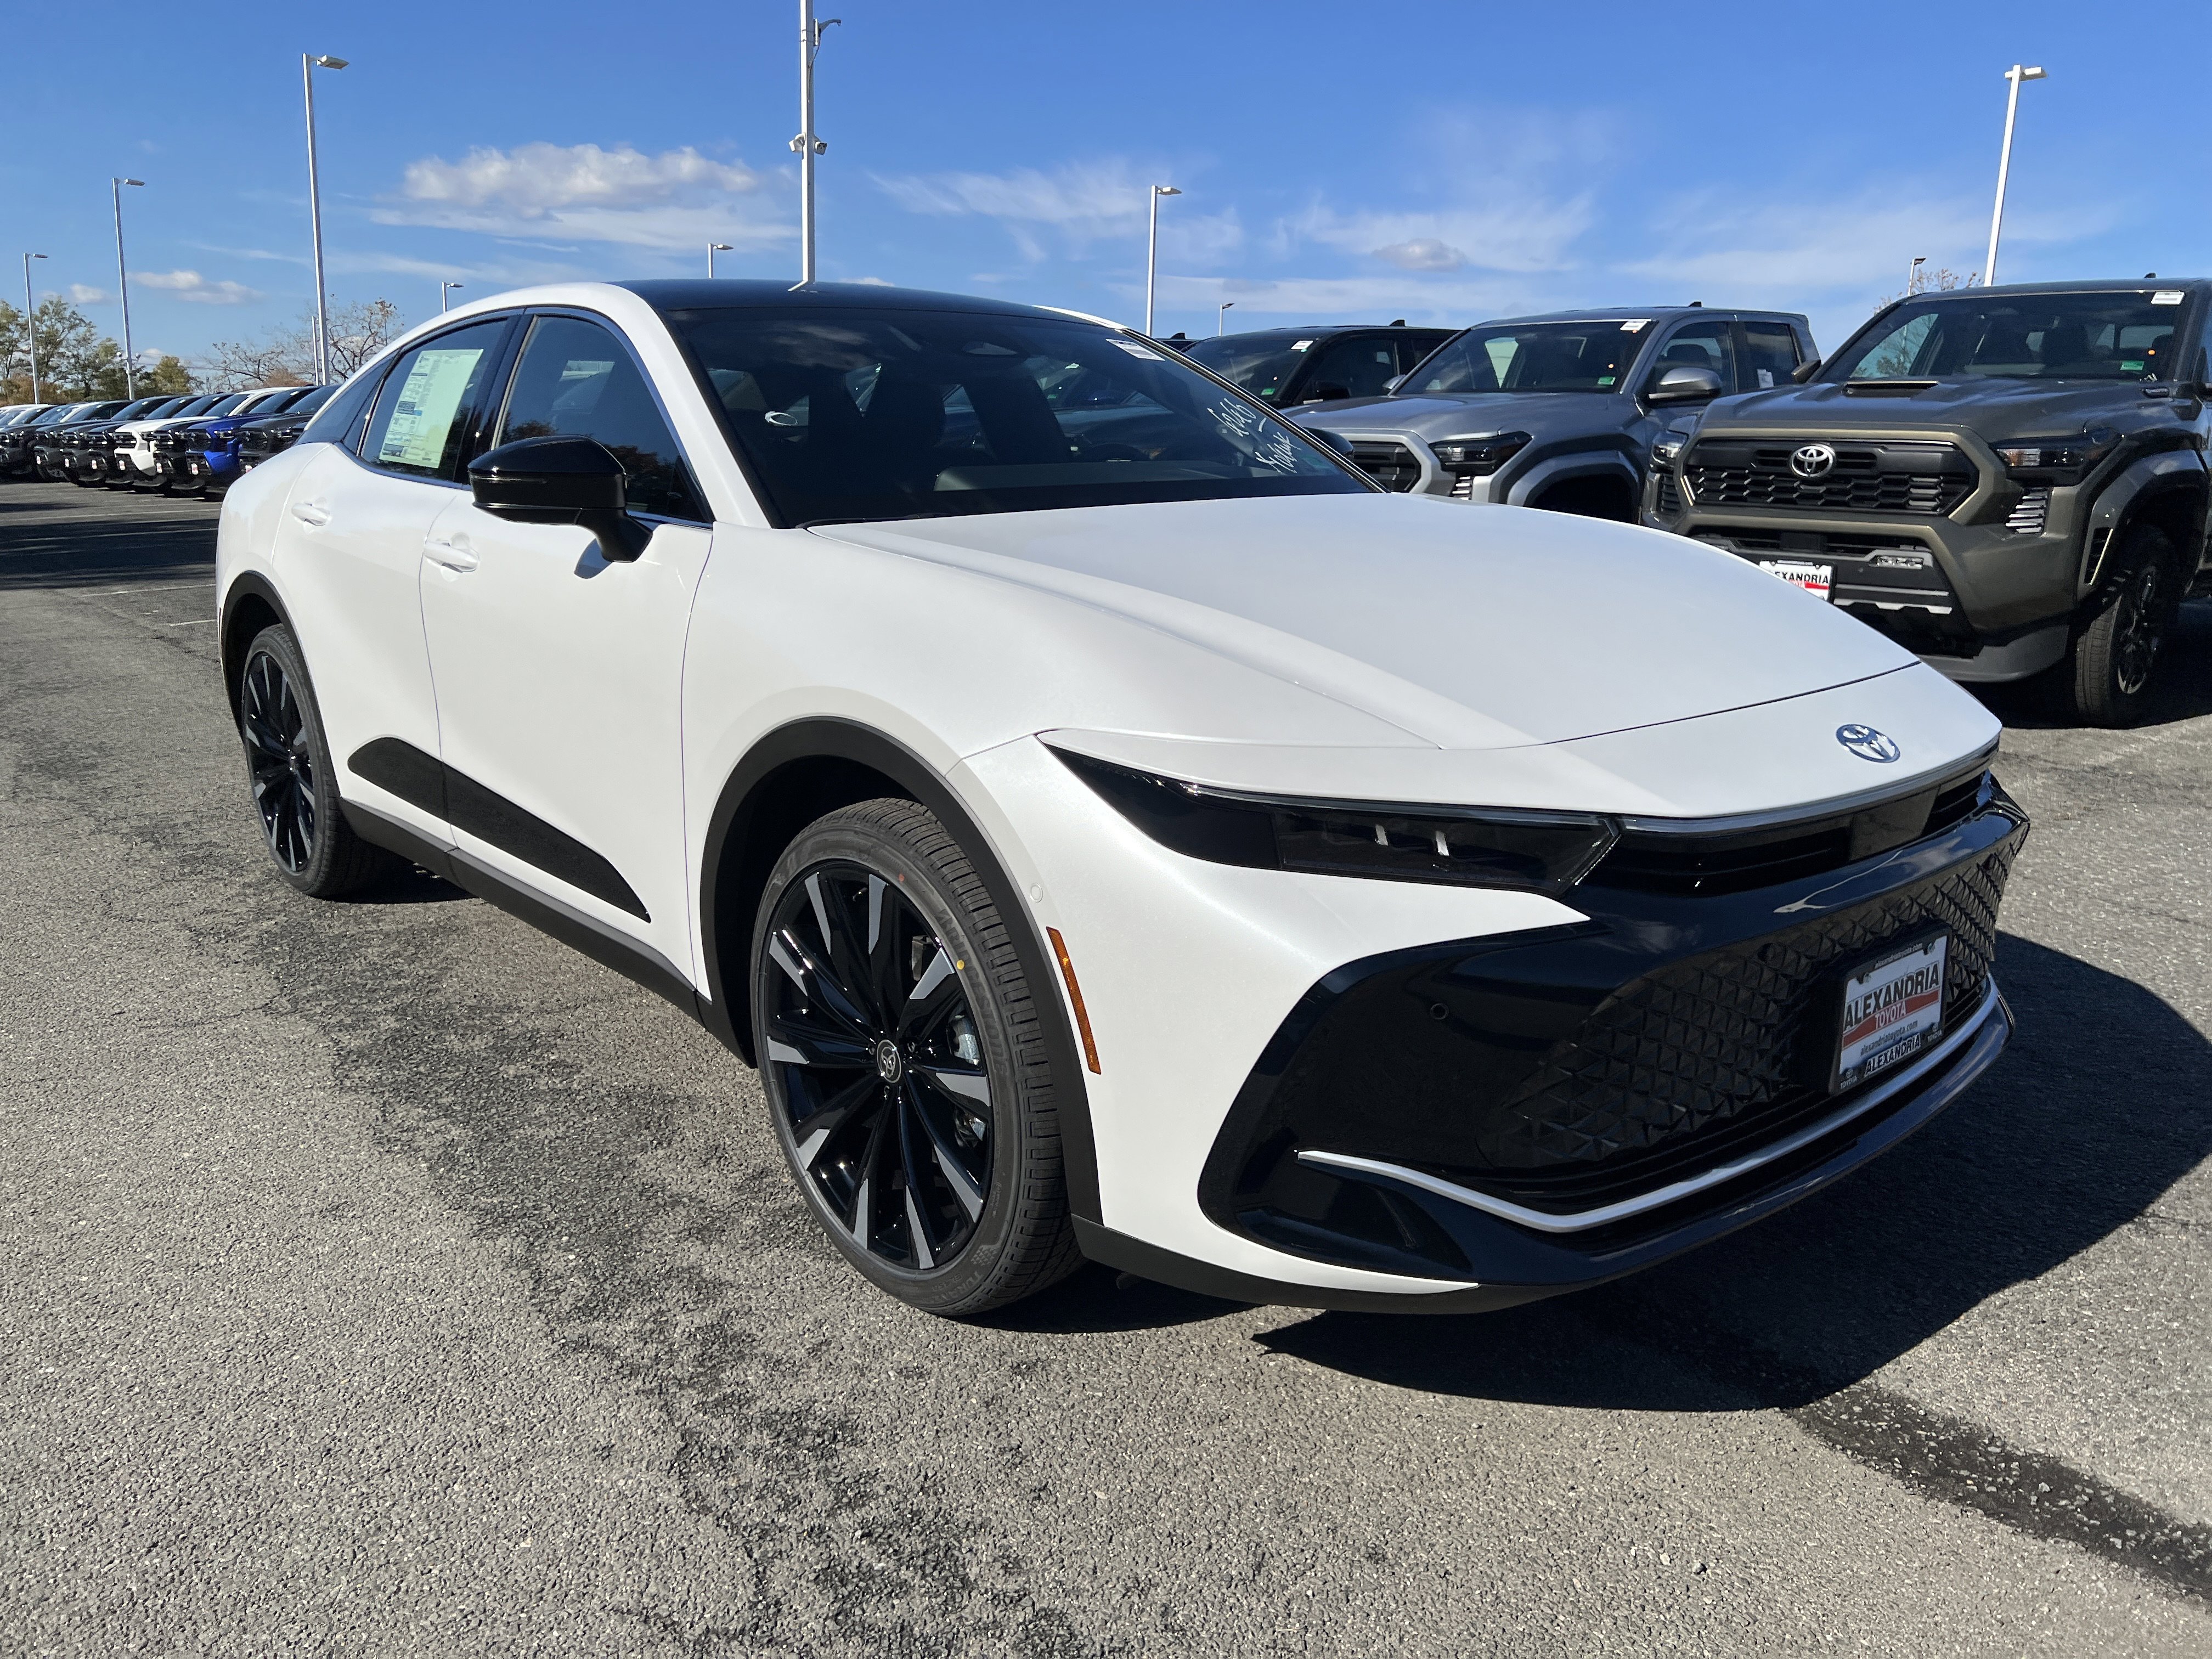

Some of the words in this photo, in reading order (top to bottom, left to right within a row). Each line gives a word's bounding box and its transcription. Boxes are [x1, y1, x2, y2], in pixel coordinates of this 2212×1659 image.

[1844, 962, 1940, 1029] ALEXANDRIA
[1875, 1002, 1906, 1029] TOYOTA
[1865, 1032, 1920, 1074] ALEXANDRIA
